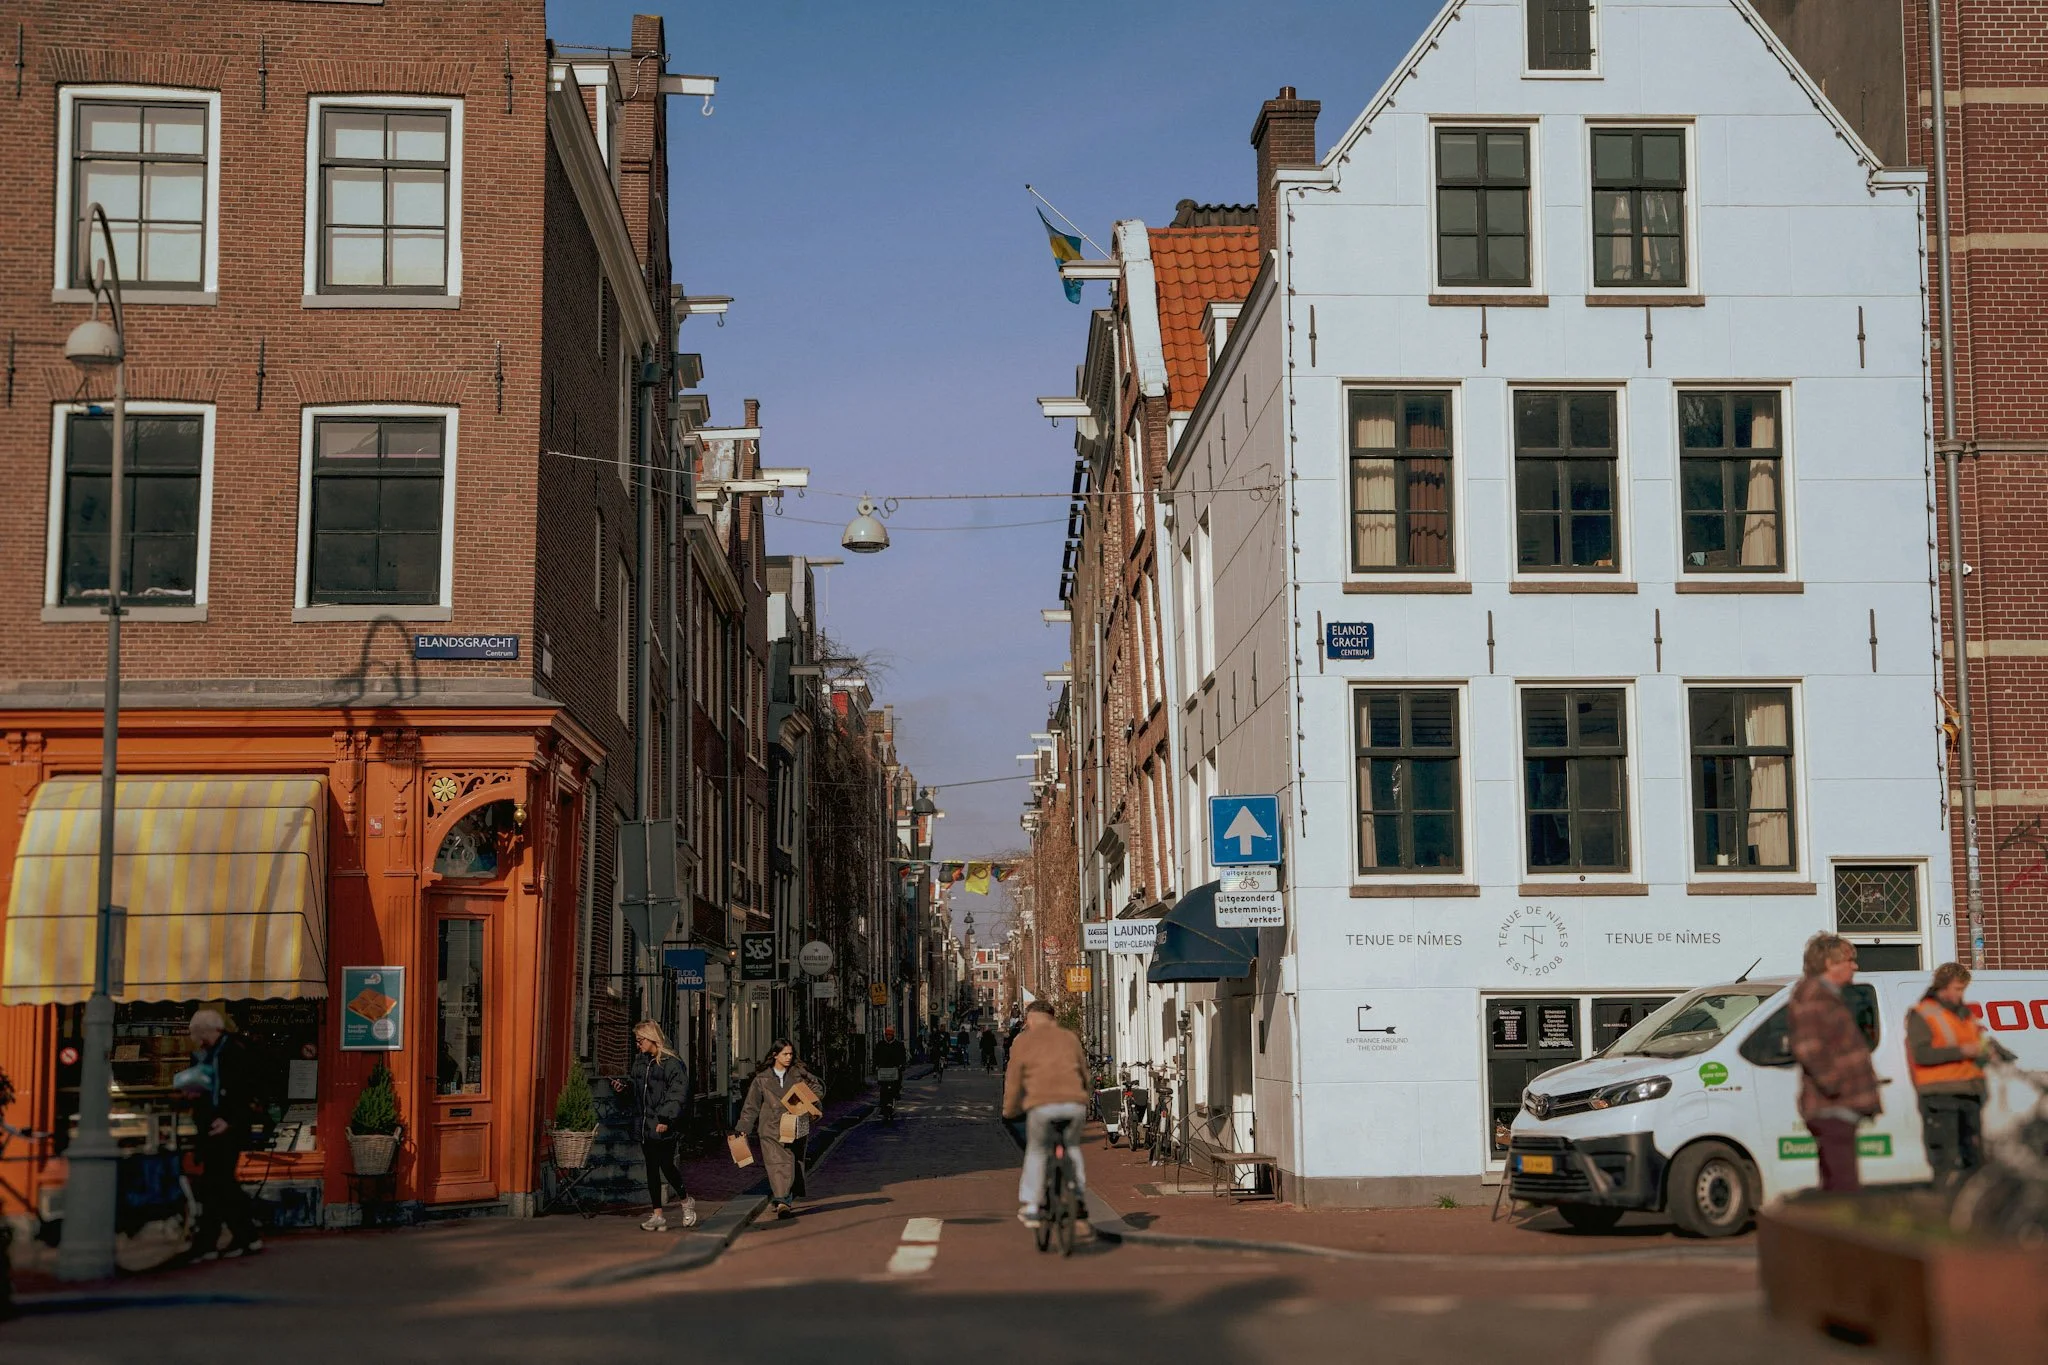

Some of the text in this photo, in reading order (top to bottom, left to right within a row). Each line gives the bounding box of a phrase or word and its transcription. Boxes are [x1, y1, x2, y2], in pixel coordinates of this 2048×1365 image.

[1332, 625, 1367, 636] ELANDS
[418, 637, 514, 648] ELANDSGRACHT
[1332, 637, 1369, 648] GRACHT
[1218, 894, 1275, 904] uitgezonderd
[1219, 906, 1281, 915] bestemmings-
[1525, 906, 1542, 915] DE
[1937, 913, 1951, 926] 76
[1114, 925, 1156, 936] LAUNDR
[1346, 934, 1395, 946] TENUE
[1398, 934, 1413, 944] DE
[1606, 932, 1653, 944] TENUE
[1657, 932, 1672, 942] DE
[745, 938, 773, 960] S&S
[675, 976, 703, 985] INTED
